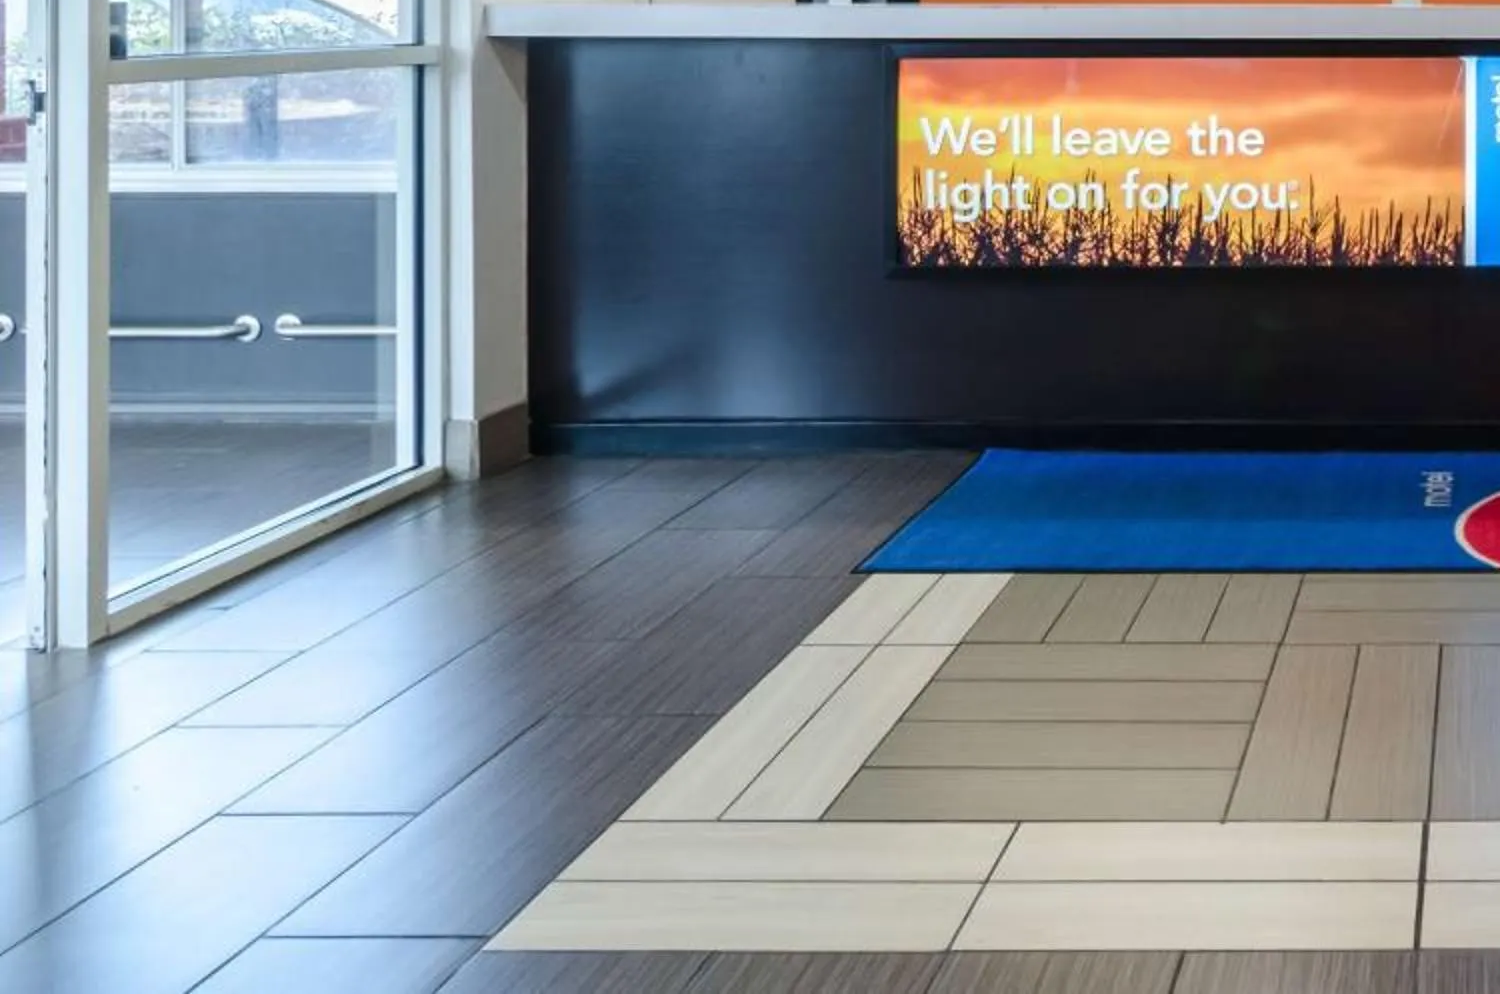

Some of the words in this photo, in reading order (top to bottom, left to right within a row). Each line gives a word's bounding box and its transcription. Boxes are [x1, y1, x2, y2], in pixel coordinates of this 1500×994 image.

[920, 114, 1034, 157] We'll
[1052, 114, 1171, 157] leave
[1186, 114, 1266, 157] the
[925, 168, 1032, 223] light
[1046, 180, 1105, 210] on
[1121, 168, 1189, 210] for
